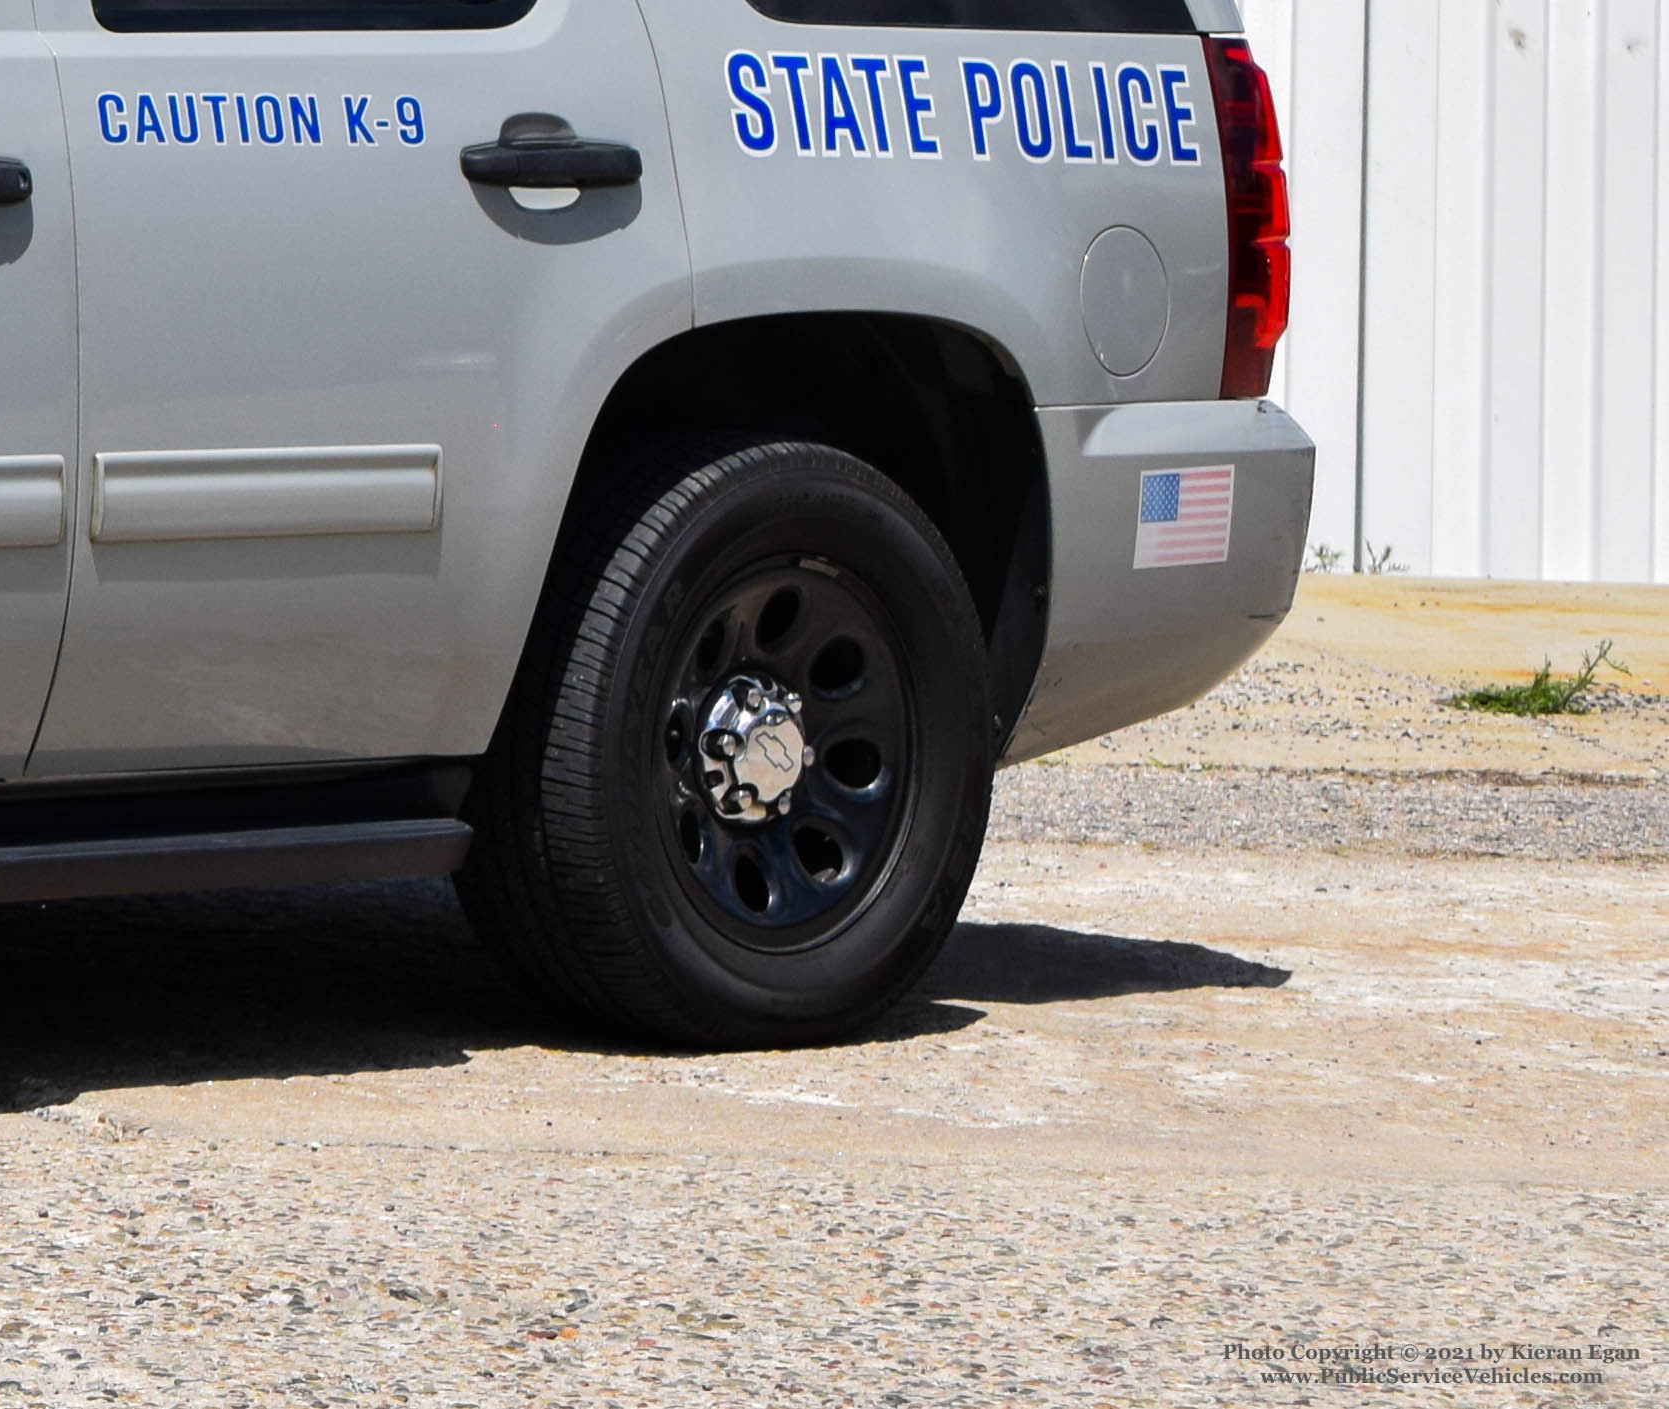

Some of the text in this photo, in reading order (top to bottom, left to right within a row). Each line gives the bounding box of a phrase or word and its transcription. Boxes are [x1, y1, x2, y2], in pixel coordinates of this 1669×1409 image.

[96, 92, 425, 145] CAUTION K-9
[726, 49, 1201, 167] STATE POLICE
